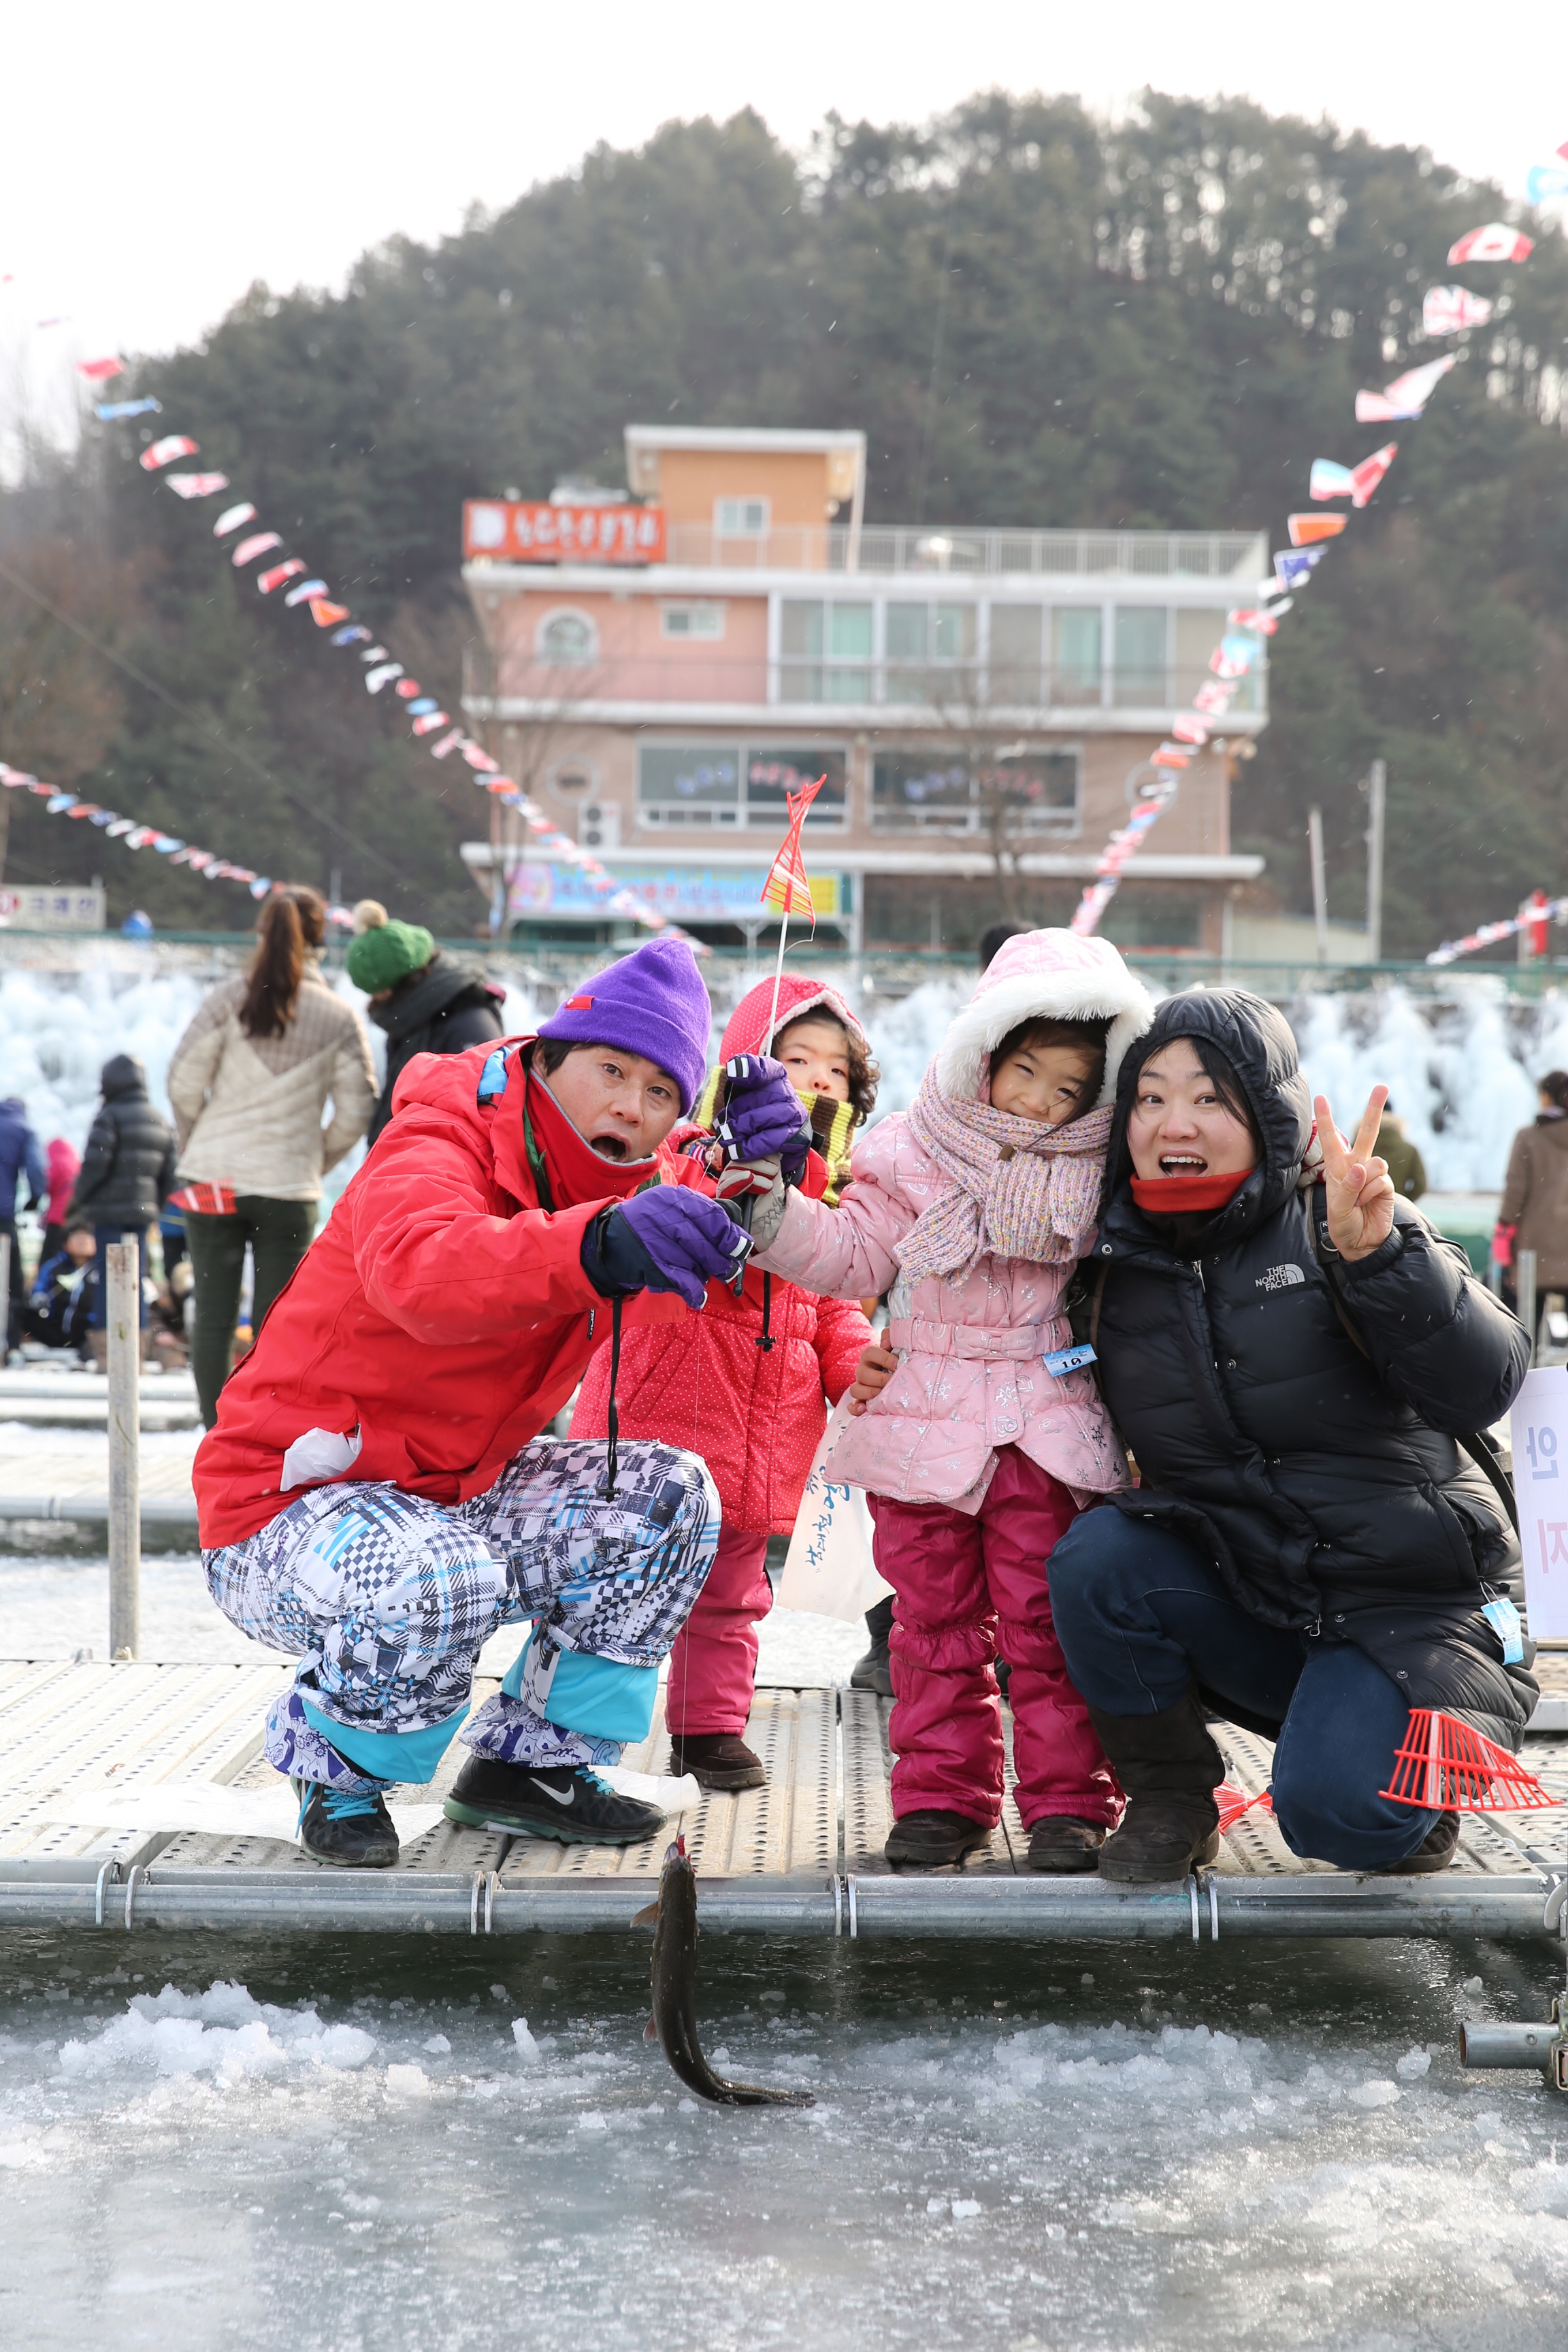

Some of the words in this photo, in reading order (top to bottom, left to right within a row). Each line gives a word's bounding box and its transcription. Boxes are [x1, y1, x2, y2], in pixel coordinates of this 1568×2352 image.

[1267, 1264, 1285, 1275] THE
[1255, 1270, 1286, 1287] NORTH
[1265, 1278, 1288, 1291] FACE
[1062, 1357, 1082, 1369] 10
